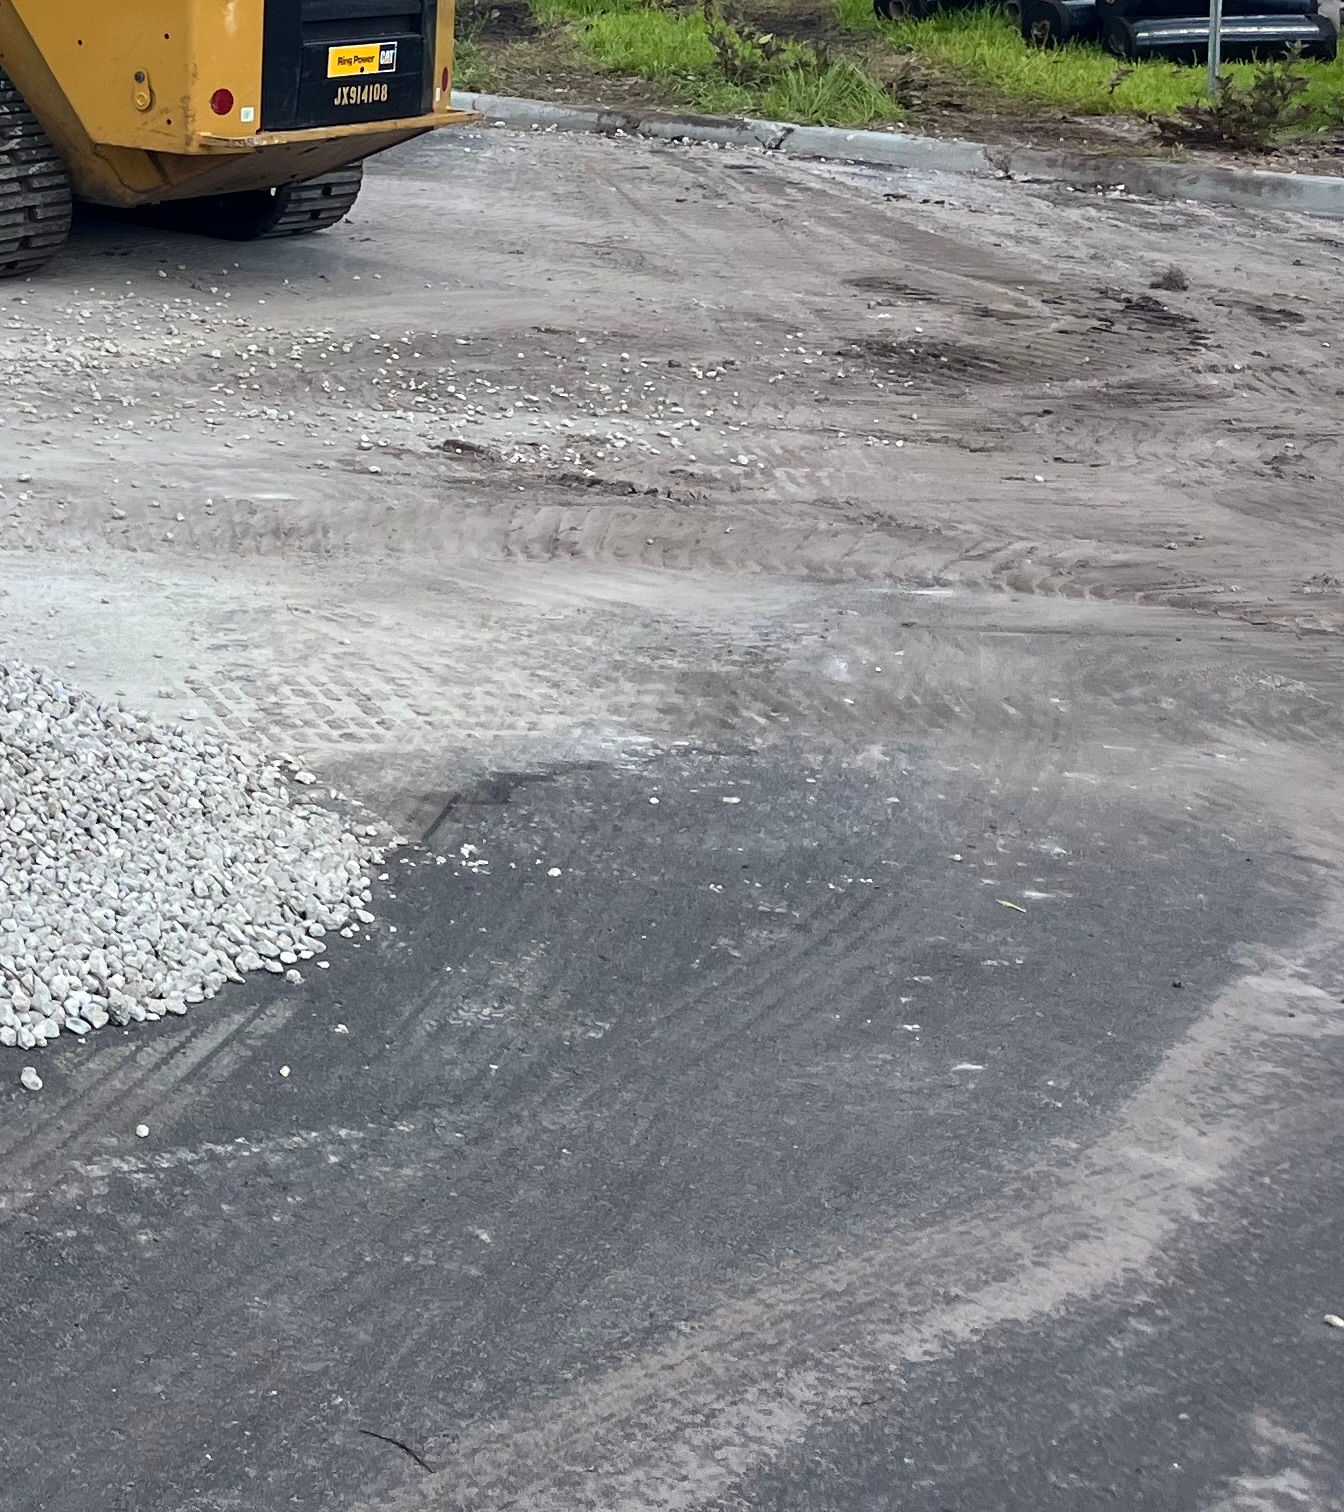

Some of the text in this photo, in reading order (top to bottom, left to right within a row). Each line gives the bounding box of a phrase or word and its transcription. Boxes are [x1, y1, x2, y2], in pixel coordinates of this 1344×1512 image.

[337, 49, 396, 66] Ring Power CAT
[333, 83, 389, 106] JX914108
